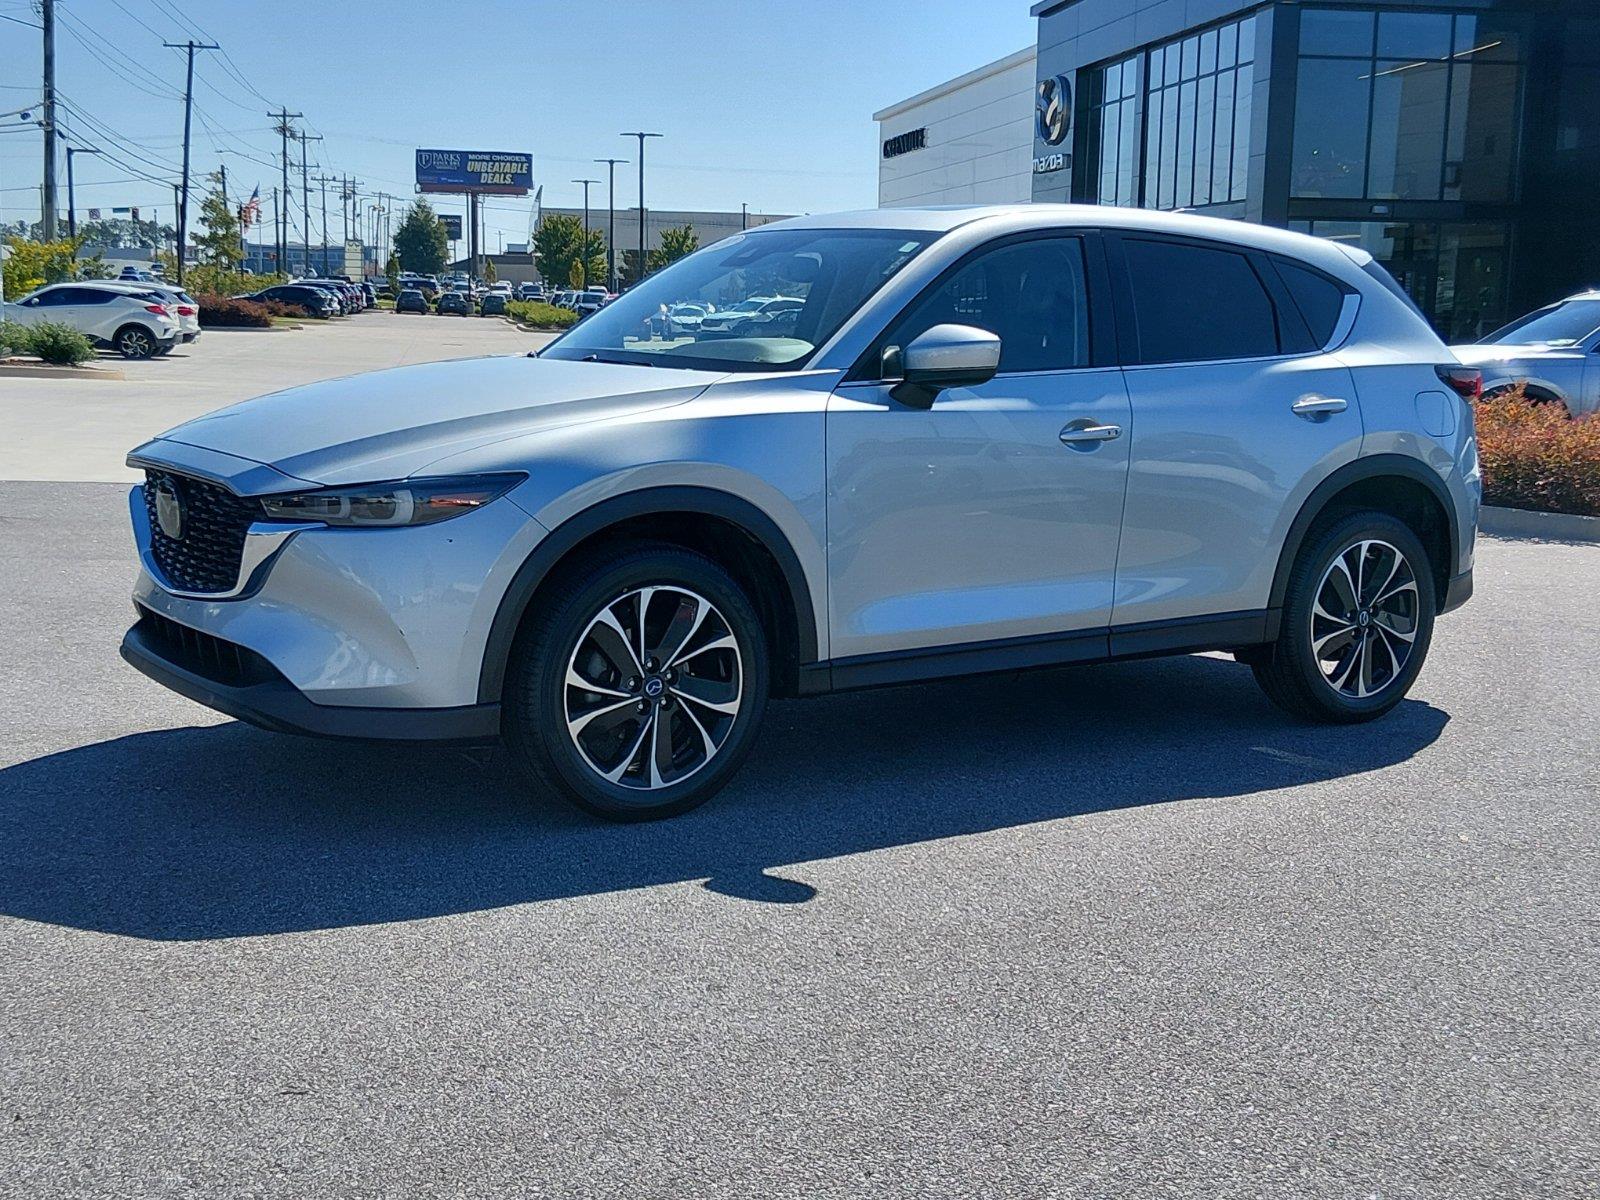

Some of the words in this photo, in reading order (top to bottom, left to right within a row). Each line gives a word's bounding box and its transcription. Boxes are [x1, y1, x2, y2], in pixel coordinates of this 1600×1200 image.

[433, 153, 461, 162] PARKS
[1032, 154, 1062, 172] mazda
[467, 161, 528, 173] UNBEATABLE
[480, 173, 514, 184] DEALS.
